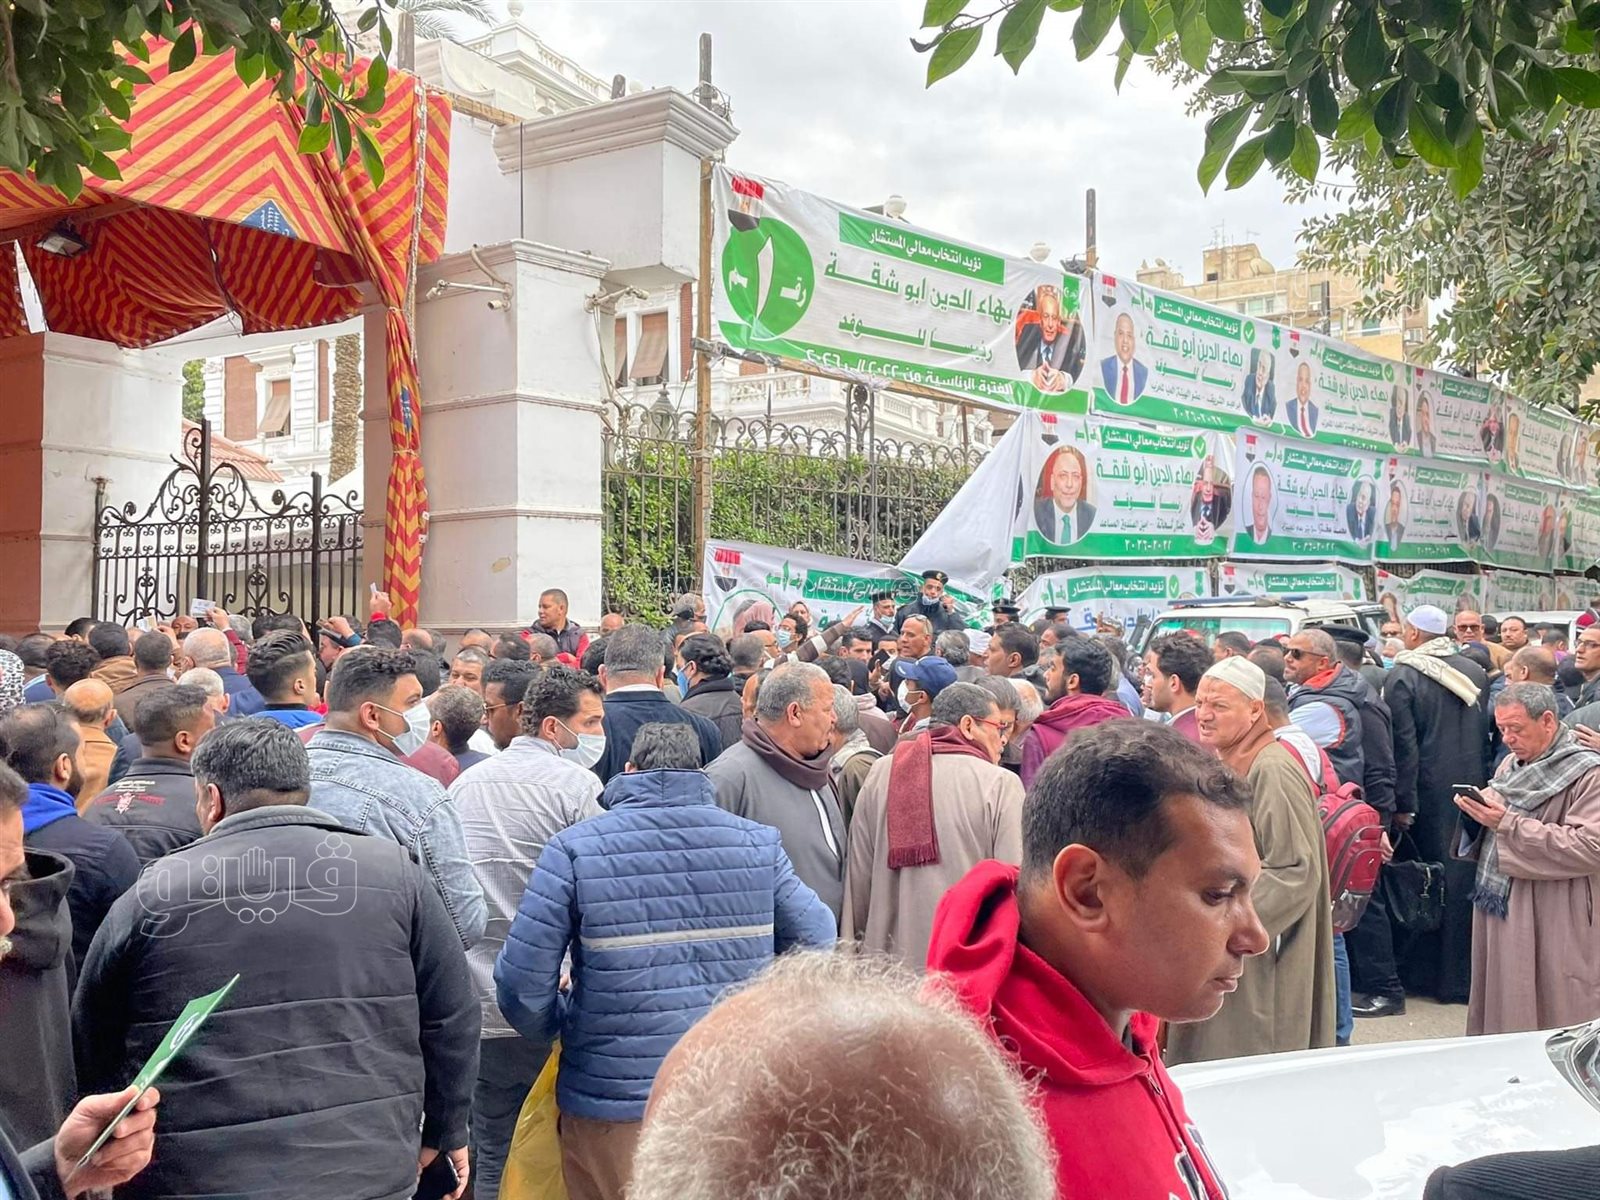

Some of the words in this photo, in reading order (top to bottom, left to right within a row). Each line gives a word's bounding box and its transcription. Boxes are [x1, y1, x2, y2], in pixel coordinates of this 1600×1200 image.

[868, 227, 906, 250] المستشار
[905, 241, 932, 258] معالي
[932, 248, 962, 264] انتخاب
[961, 257, 982, 273] نؤيد
[929, 287, 973, 312] الدين
[975, 294, 1014, 326] بهاء
[1157, 301, 1184, 316] المستشار
[1197, 338, 1221, 363] الدين
[1221, 346, 1243, 372] بهاء
[902, 366, 922, 383] من
[924, 371, 976, 390] الرئاسية
[977, 379, 1014, 396] الفترة
[1104, 429, 1132, 444] المستشار
[1149, 462, 1174, 487] الدين
[808, 576, 855, 593] المستشار
[1071, 579, 1102, 597] المستشار
[1101, 580, 1123, 596] معالي
[1123, 580, 1149, 595] انتخاب
